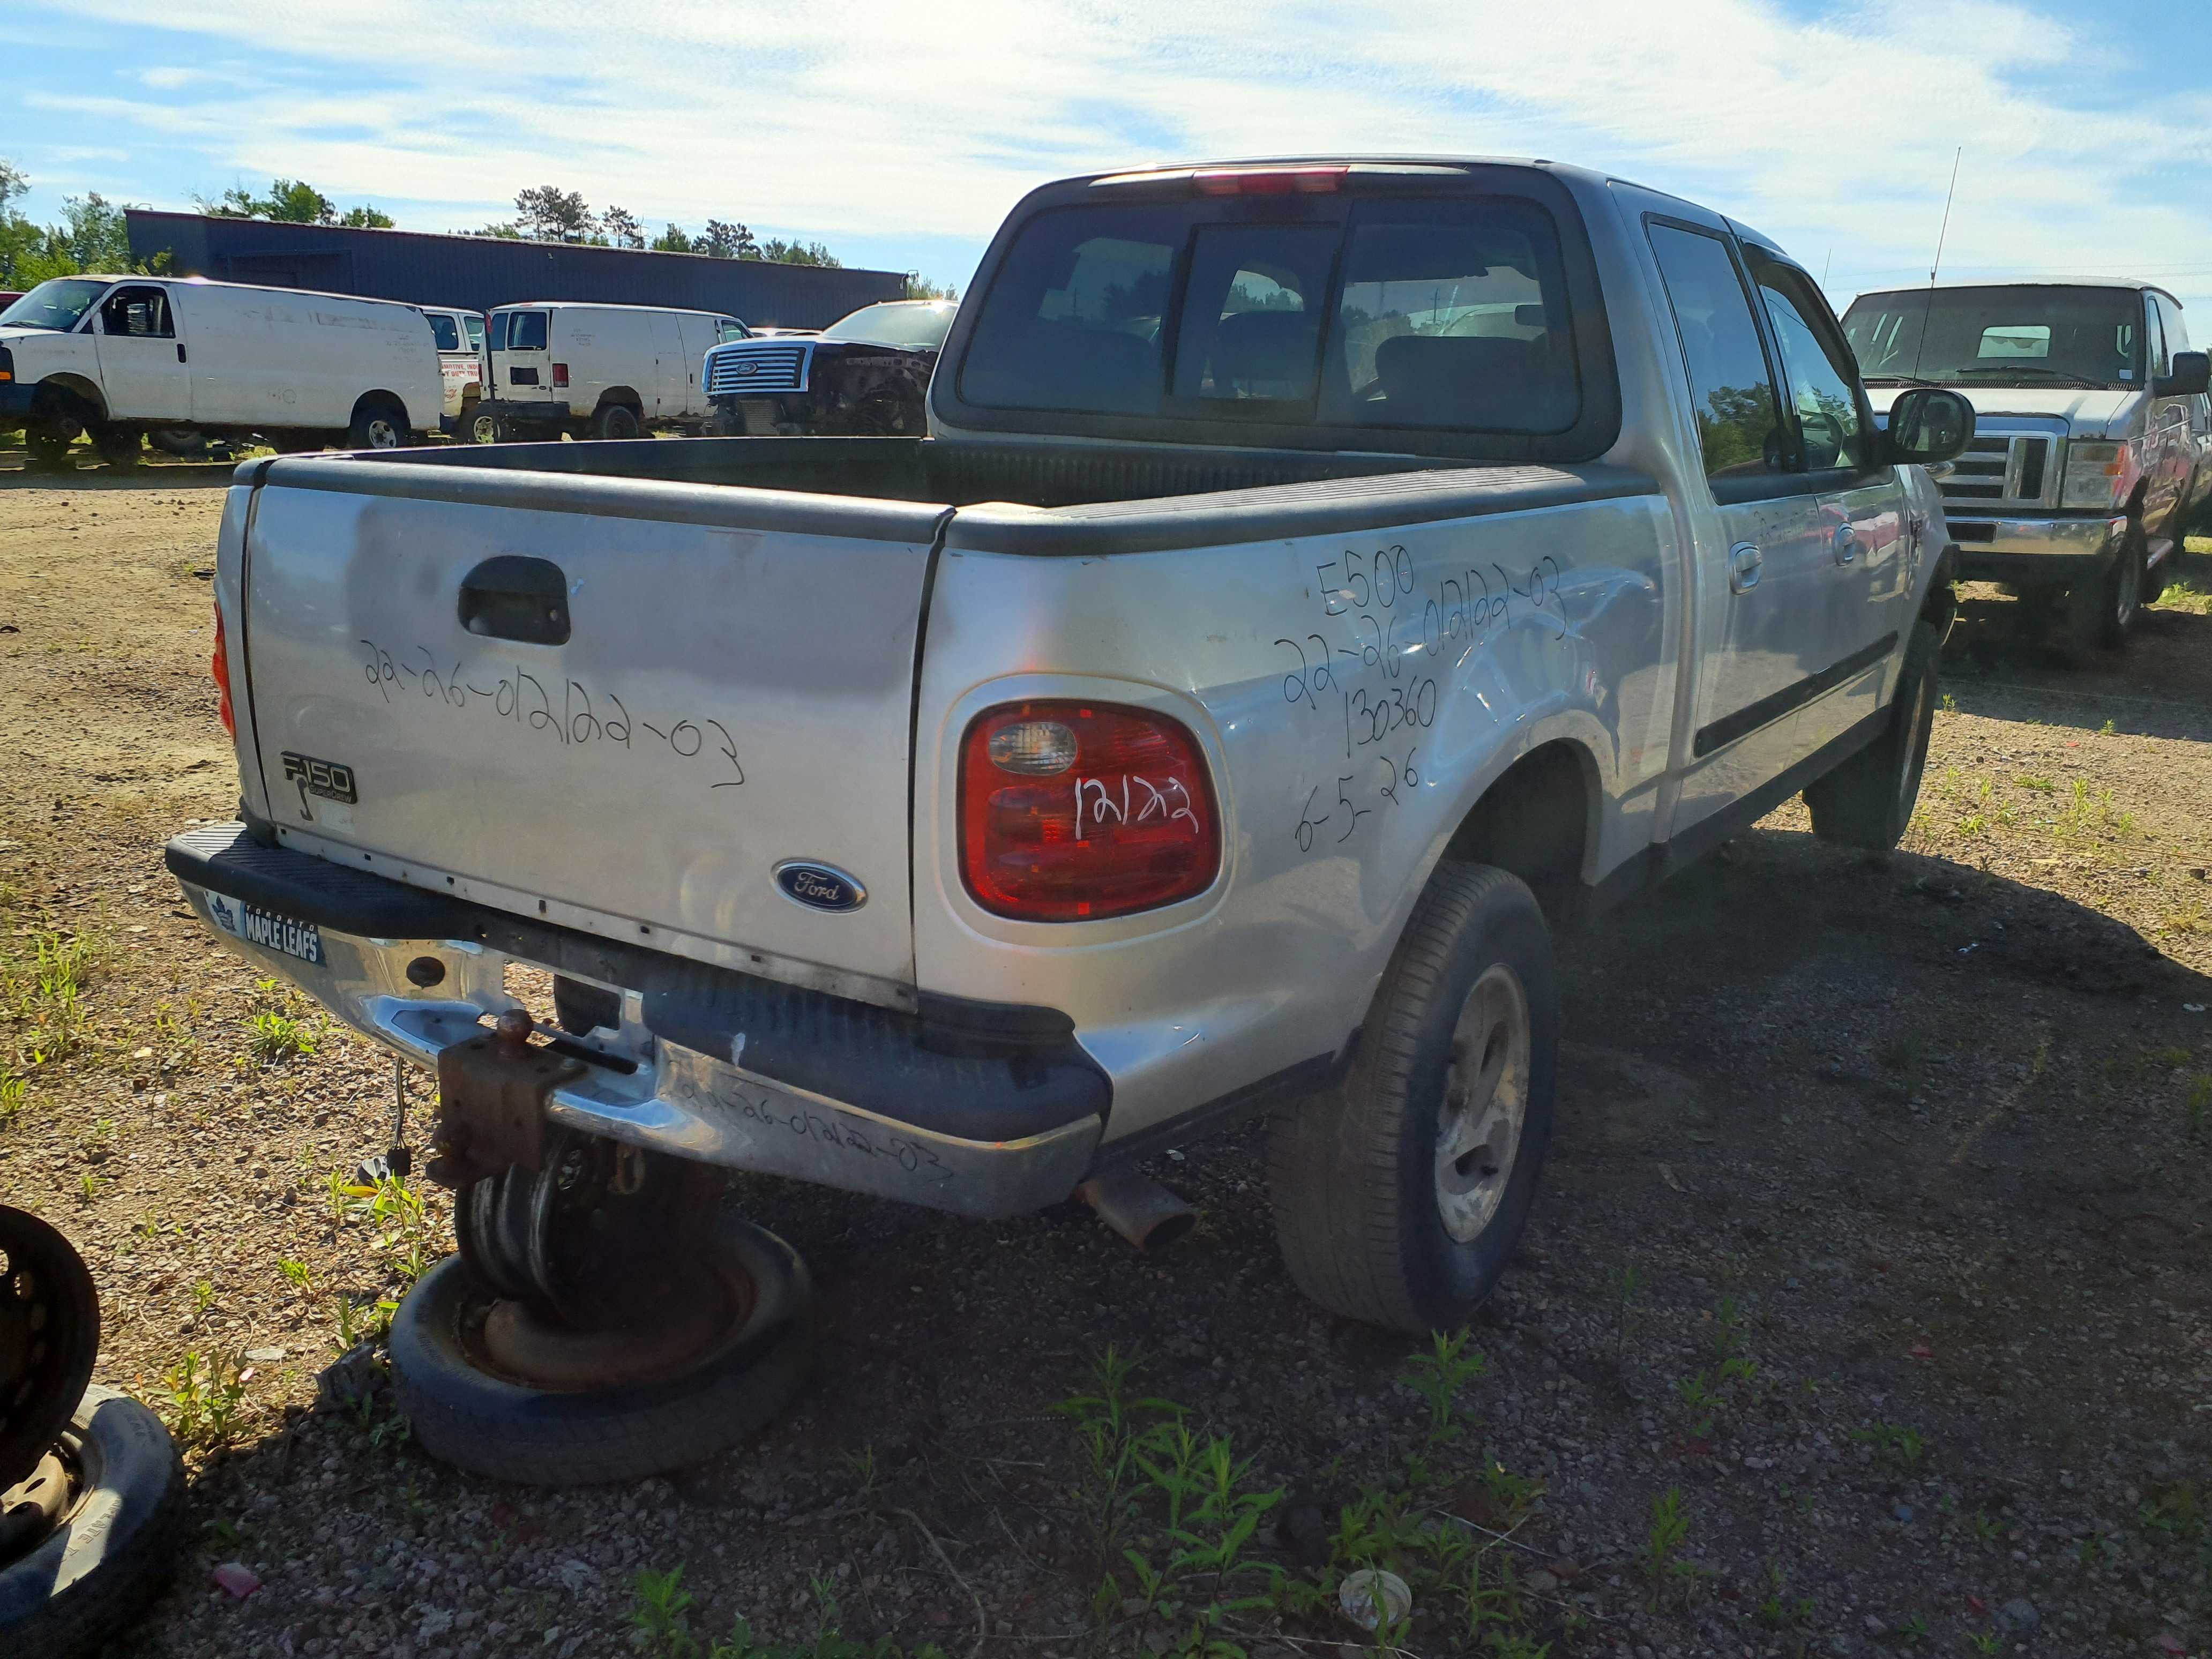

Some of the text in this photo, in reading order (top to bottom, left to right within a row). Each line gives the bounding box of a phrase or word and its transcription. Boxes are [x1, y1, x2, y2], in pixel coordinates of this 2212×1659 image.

[360, 639, 745, 788] 22-26-012122-03
[1345, 676, 1436, 759] 130360
[1075, 774, 1200, 840] 12122
[793, 871, 840, 900] Ford
[245, 911, 318, 962] MAPLE LEAFS
[246, 904, 315, 932] TORONTO
